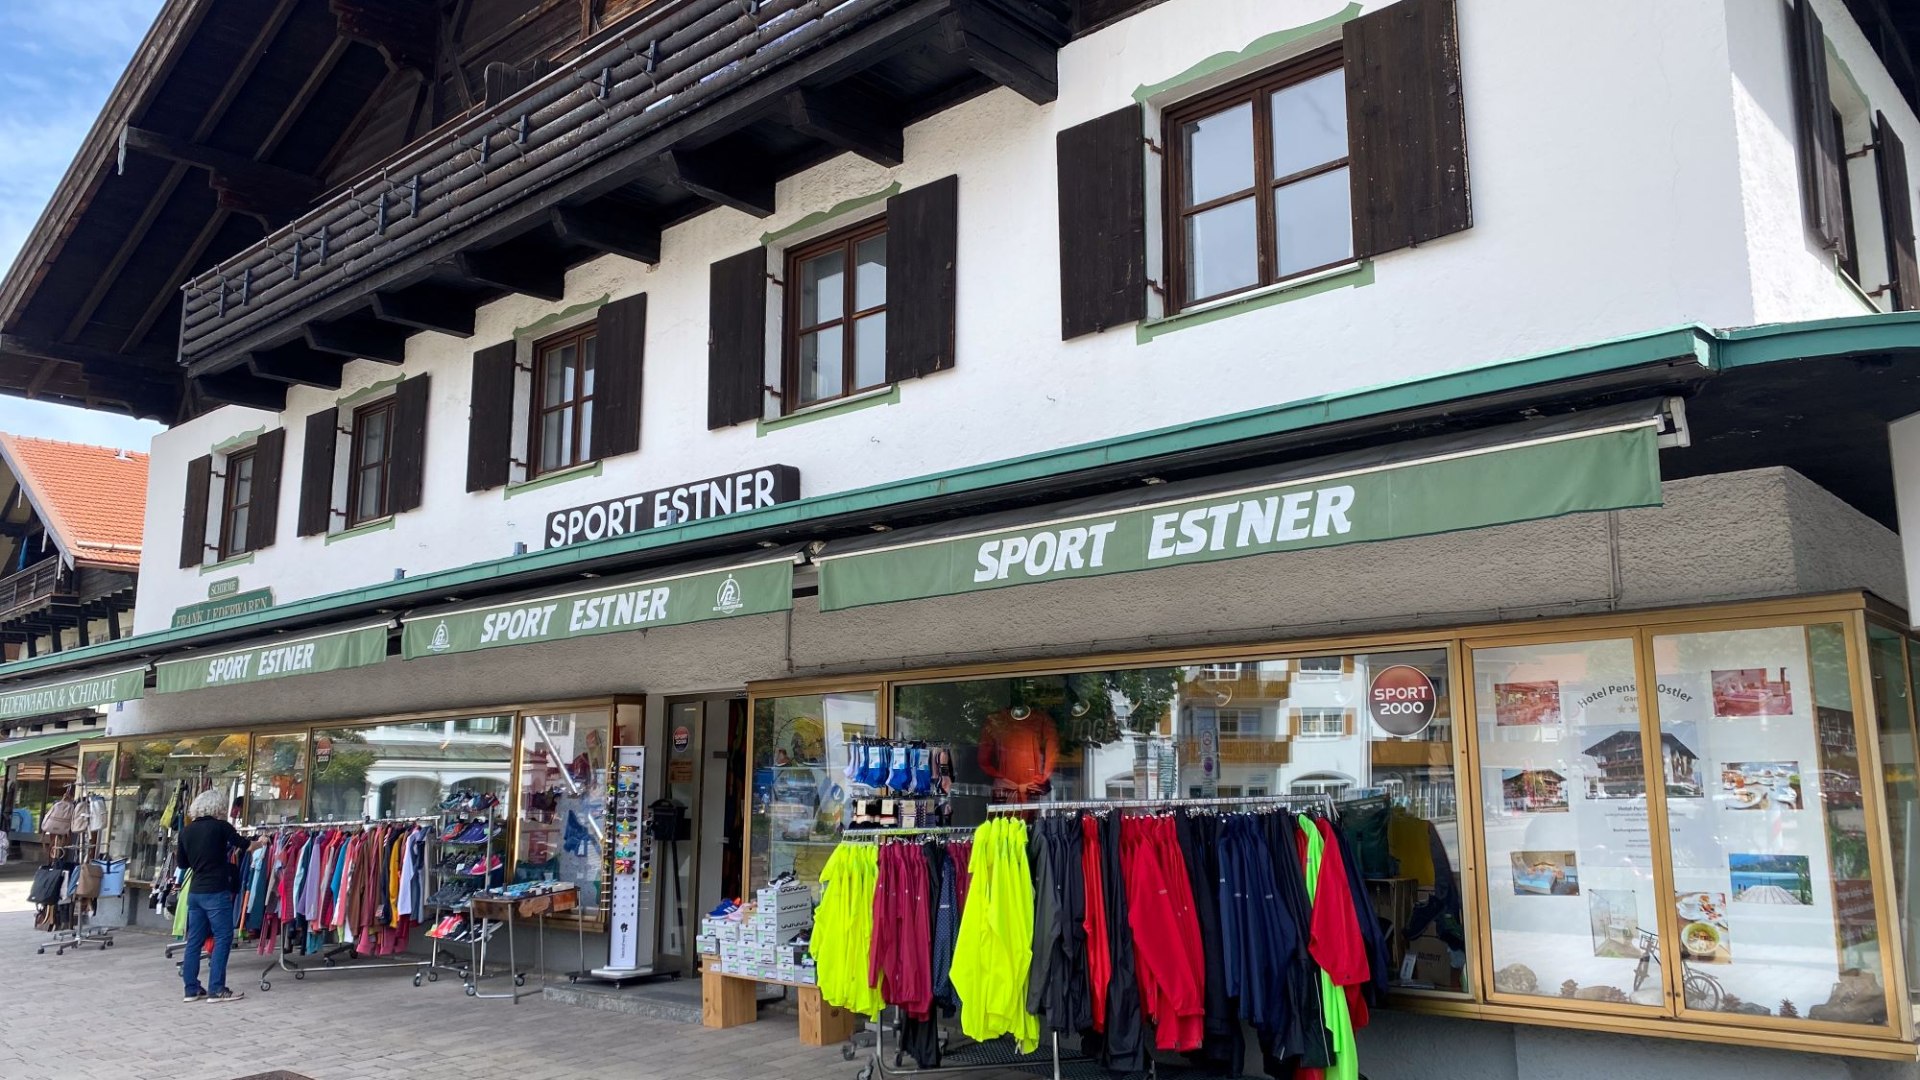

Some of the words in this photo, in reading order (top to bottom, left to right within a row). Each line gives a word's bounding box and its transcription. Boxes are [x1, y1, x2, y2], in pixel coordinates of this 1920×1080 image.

[550, 497, 643, 548] SPORT
[653, 470, 775, 528] ESTNER
[973, 520, 1117, 583] SPORT
[1147, 484, 1356, 561] ESTNER
[210, 580, 237, 595] SCHIRME
[176, 610, 205, 626] FRANK
[480, 603, 558, 643] SPORT
[569, 587, 670, 632] ESTNER
[207, 653, 253, 683] SPORT
[258, 643, 315, 677] ESTNER
[57, 688, 66, 707] &
[68, 679, 117, 705] SCHIRME
[1374, 685, 1429, 701] SPORT
[1577, 687, 1607, 708] Hotel
[1657, 683, 1694, 703] Ostler
[1379, 701, 1424, 716] 2000
